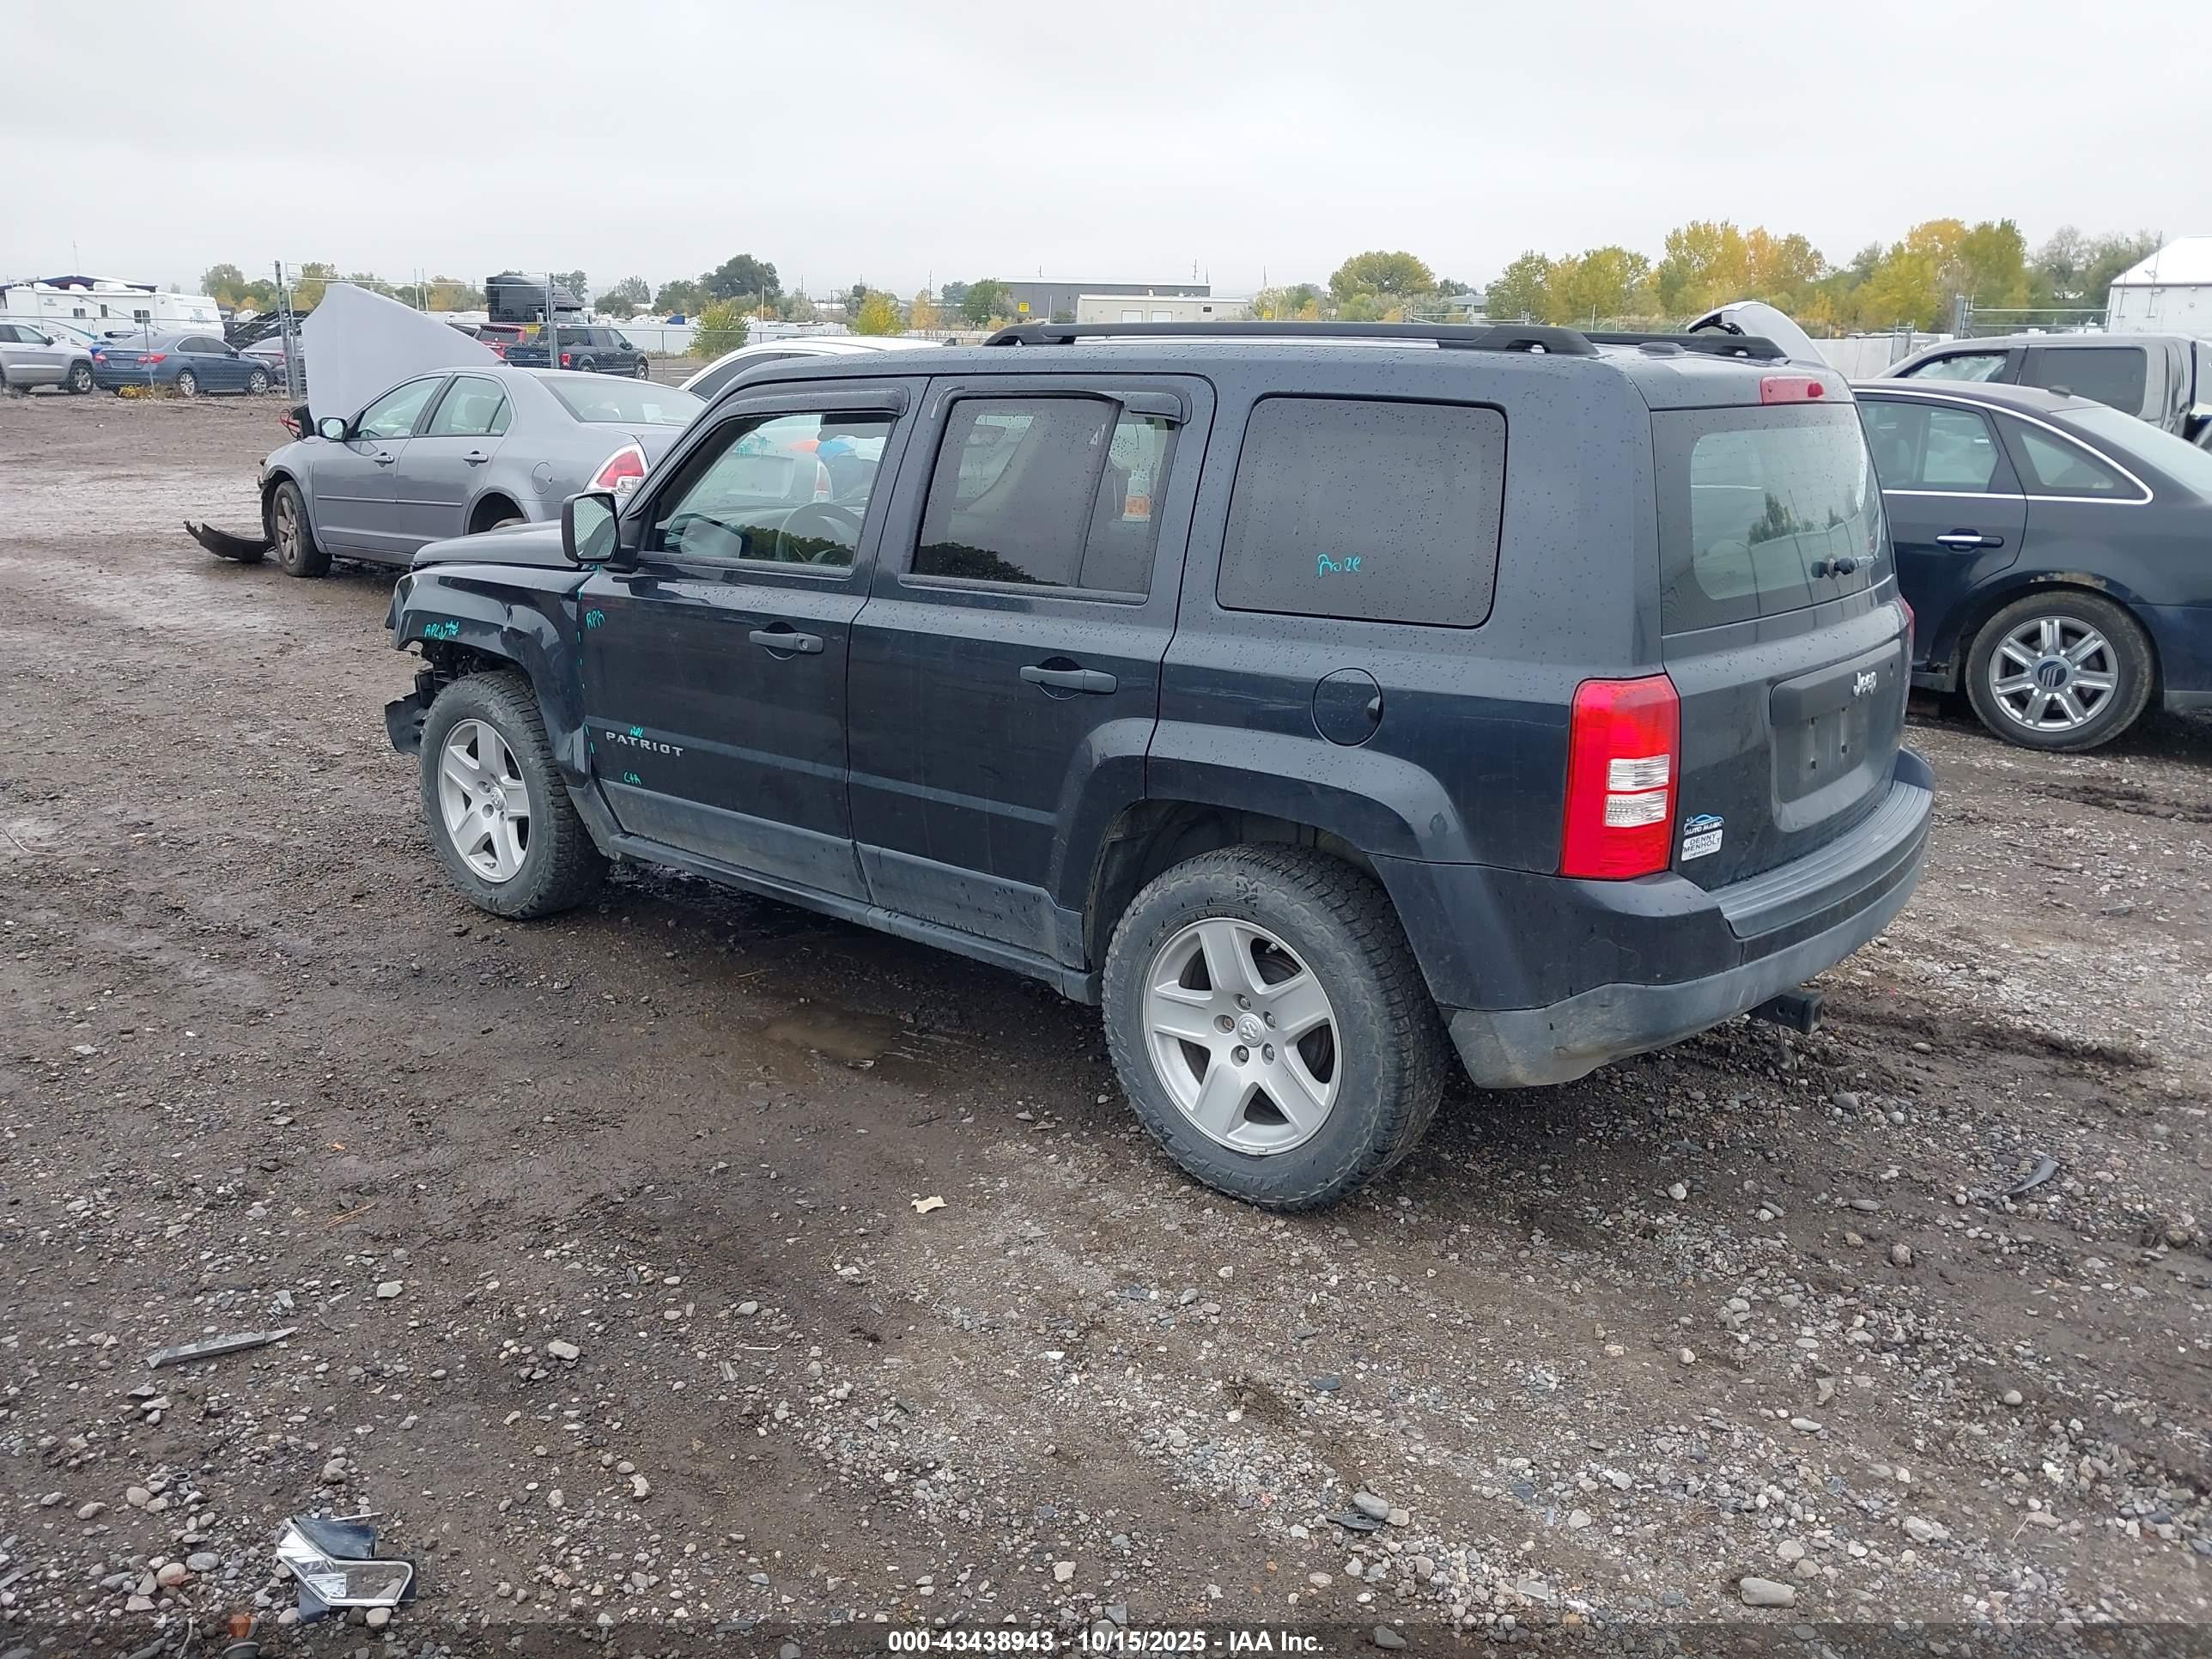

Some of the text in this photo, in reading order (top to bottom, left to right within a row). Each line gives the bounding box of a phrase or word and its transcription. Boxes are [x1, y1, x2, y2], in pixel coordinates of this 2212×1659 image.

[1852, 671, 1877, 697] Jeep
[605, 731, 684, 757] PATRIOT
[1684, 827, 1702, 836] AUTO
[1690, 833, 1717, 845] DENNY
[1683, 837, 1721, 853] MENHOLT
